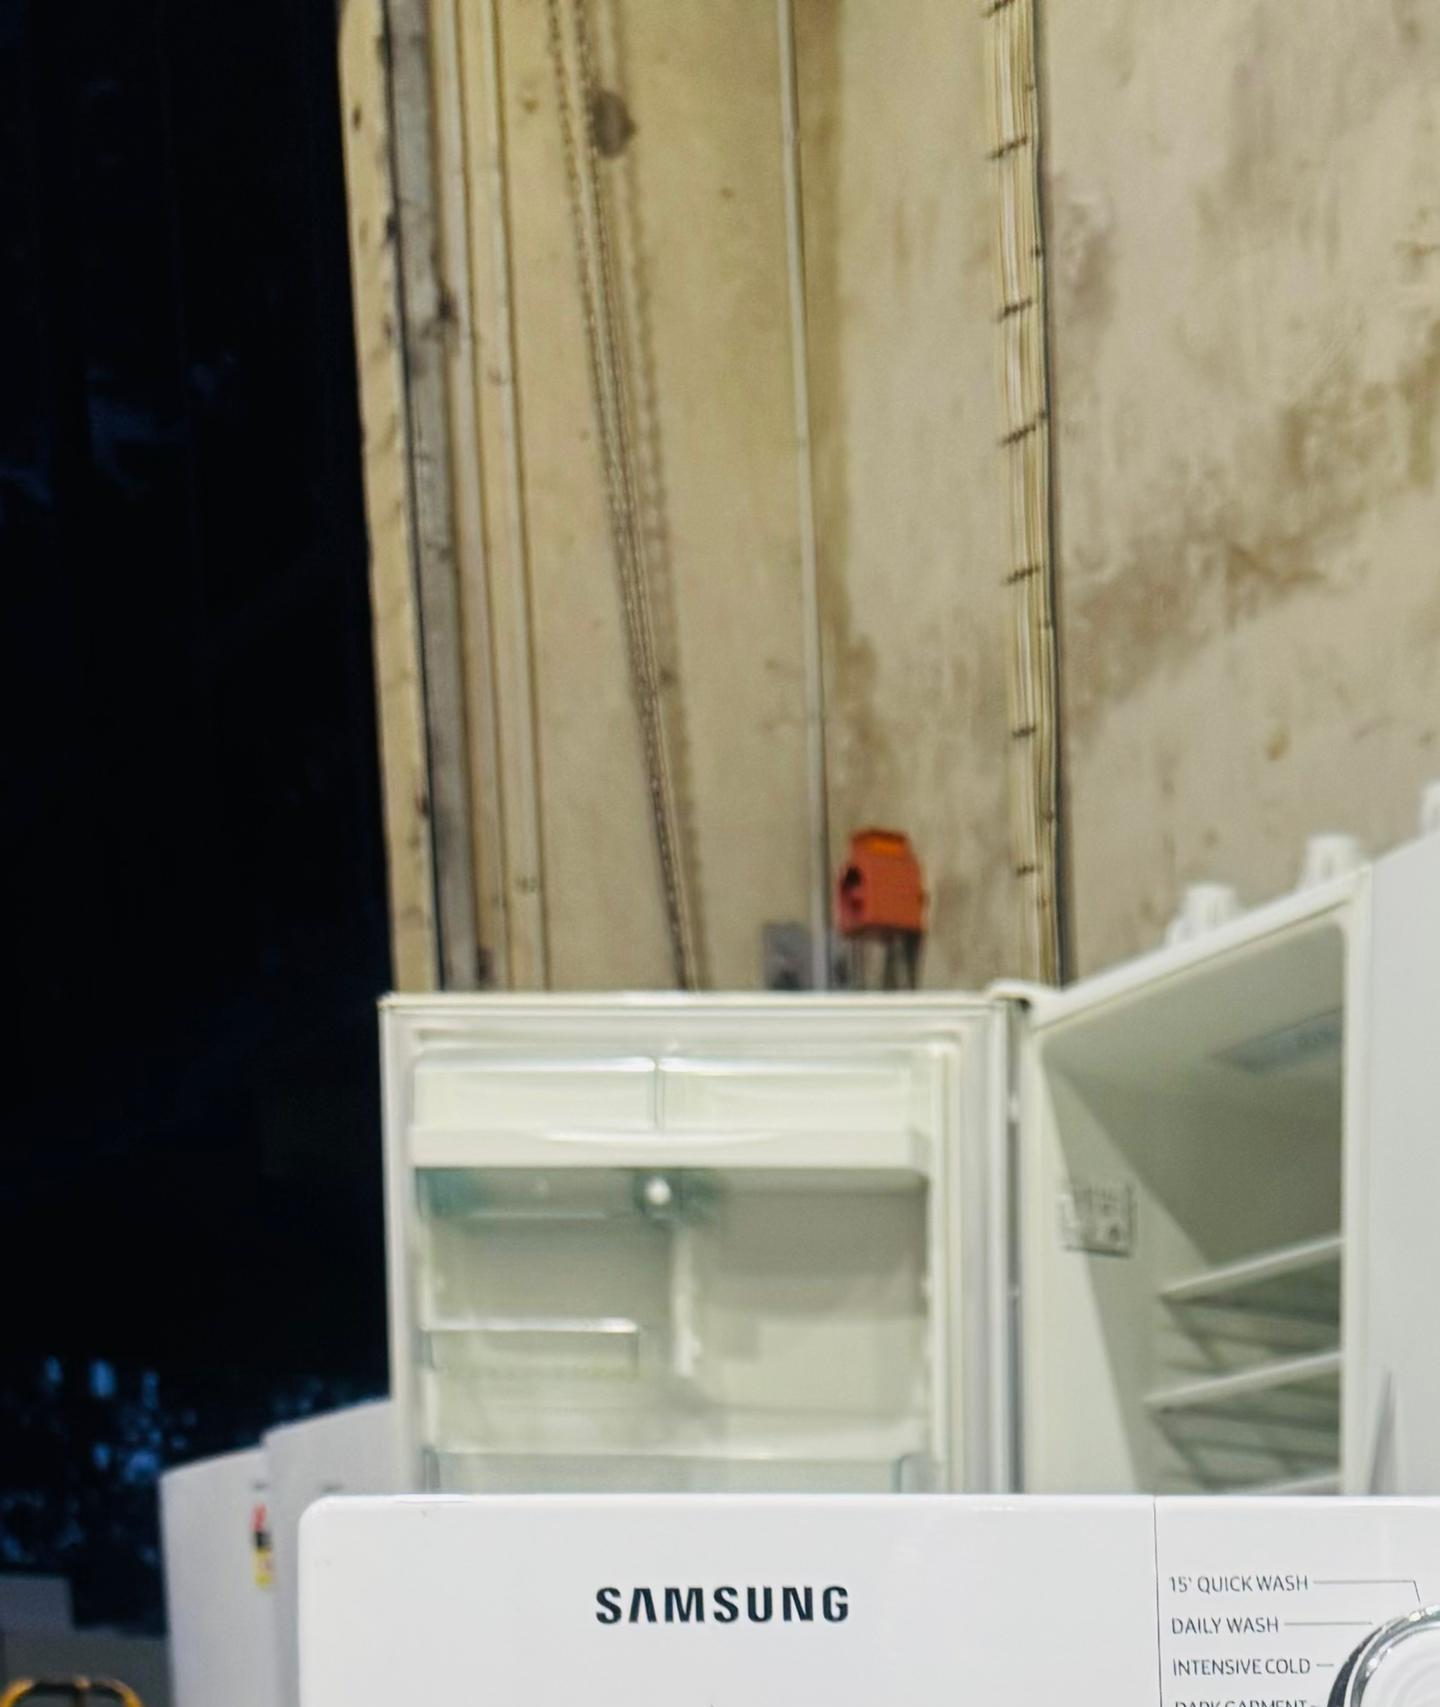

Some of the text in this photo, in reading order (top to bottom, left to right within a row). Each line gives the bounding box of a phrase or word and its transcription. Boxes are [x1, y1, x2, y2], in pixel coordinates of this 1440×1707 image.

[1197, 1575, 1253, 1594] QUICK
[1256, 1575, 1308, 1592] WASH
[594, 1585, 850, 1625] SAMSUNG
[1171, 1617, 1279, 1634] DAILY WASH
[1173, 1658, 1311, 1676] INTENSIVE COLD
